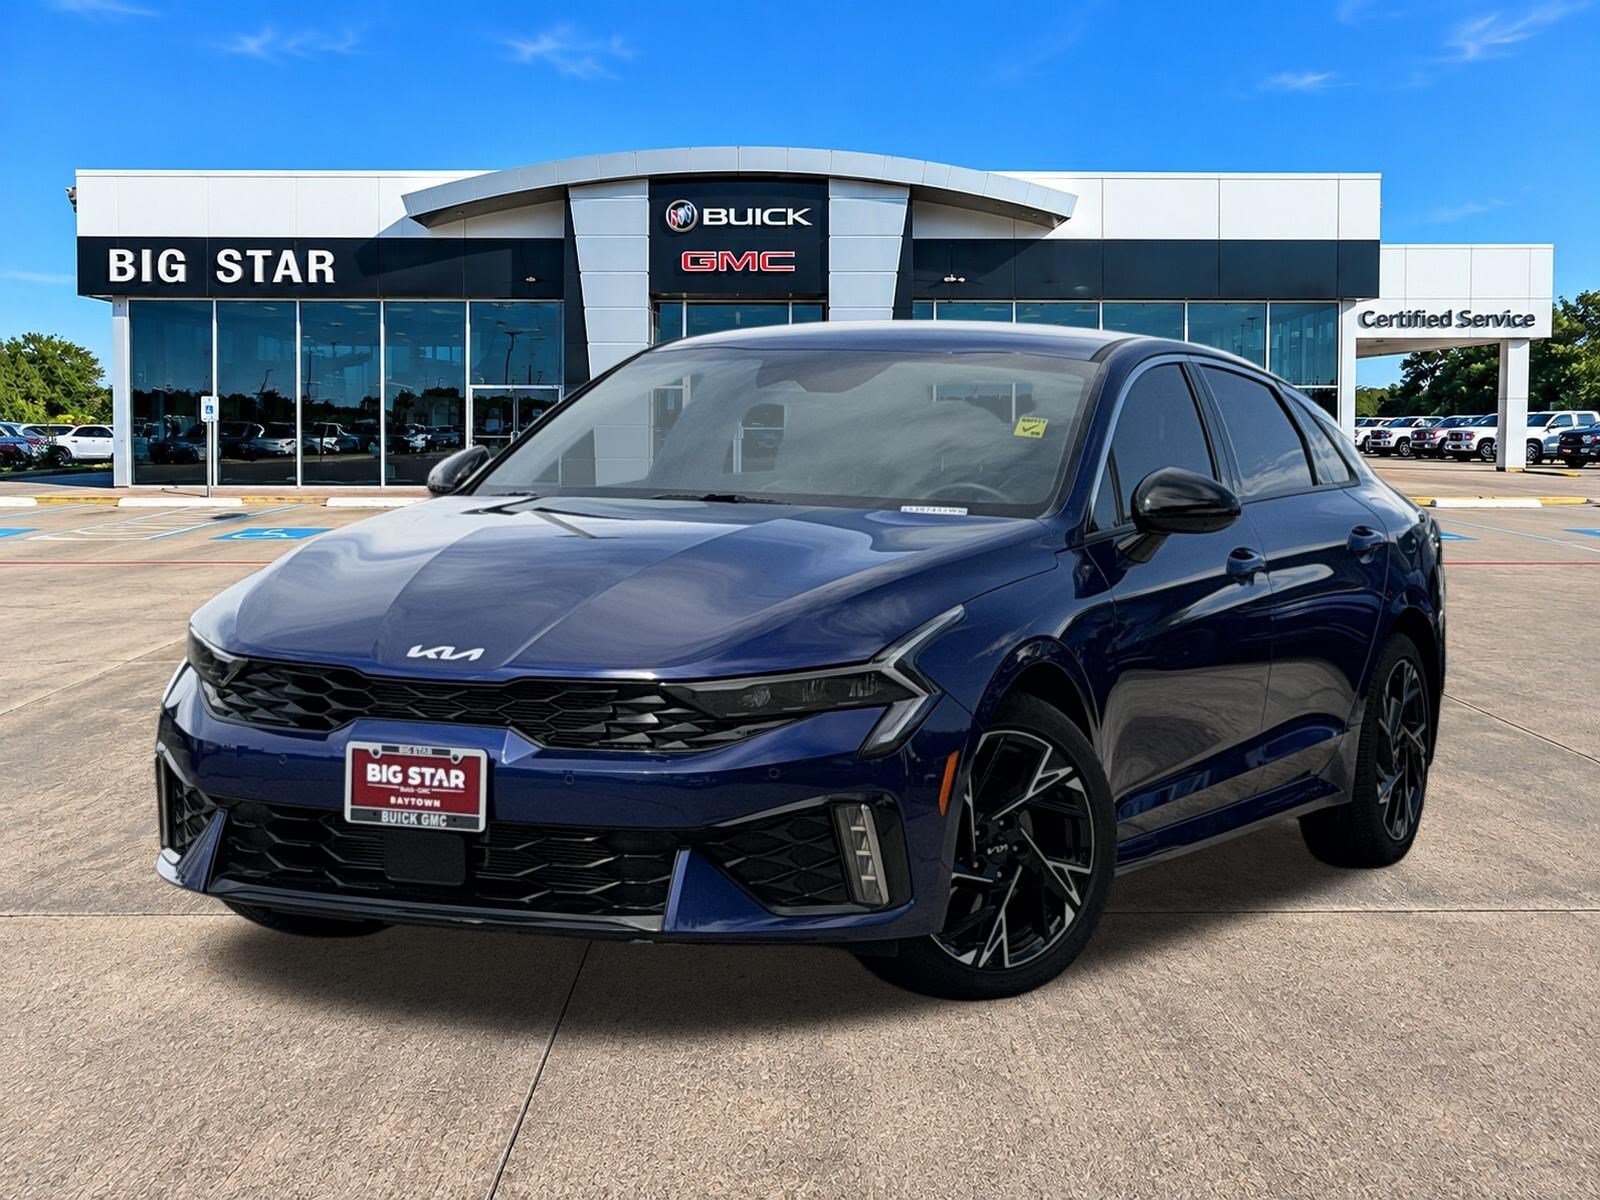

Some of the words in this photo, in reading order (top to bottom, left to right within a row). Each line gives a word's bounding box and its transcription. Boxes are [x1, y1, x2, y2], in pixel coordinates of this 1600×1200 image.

[703, 208, 813, 226] BUICK
[109, 248, 187, 283] BIG
[216, 248, 336, 284] STAR
[681, 251, 795, 272] GMC
[1359, 309, 1453, 329] Certified
[1455, 309, 1536, 329] Service
[406, 644, 485, 661] KIA
[366, 763, 403, 784] BIG
[407, 766, 466, 788] STAR
[389, 796, 441, 807] BAYTOWN
[381, 810, 418, 825] BUICK
[421, 813, 448, 827] GMC
